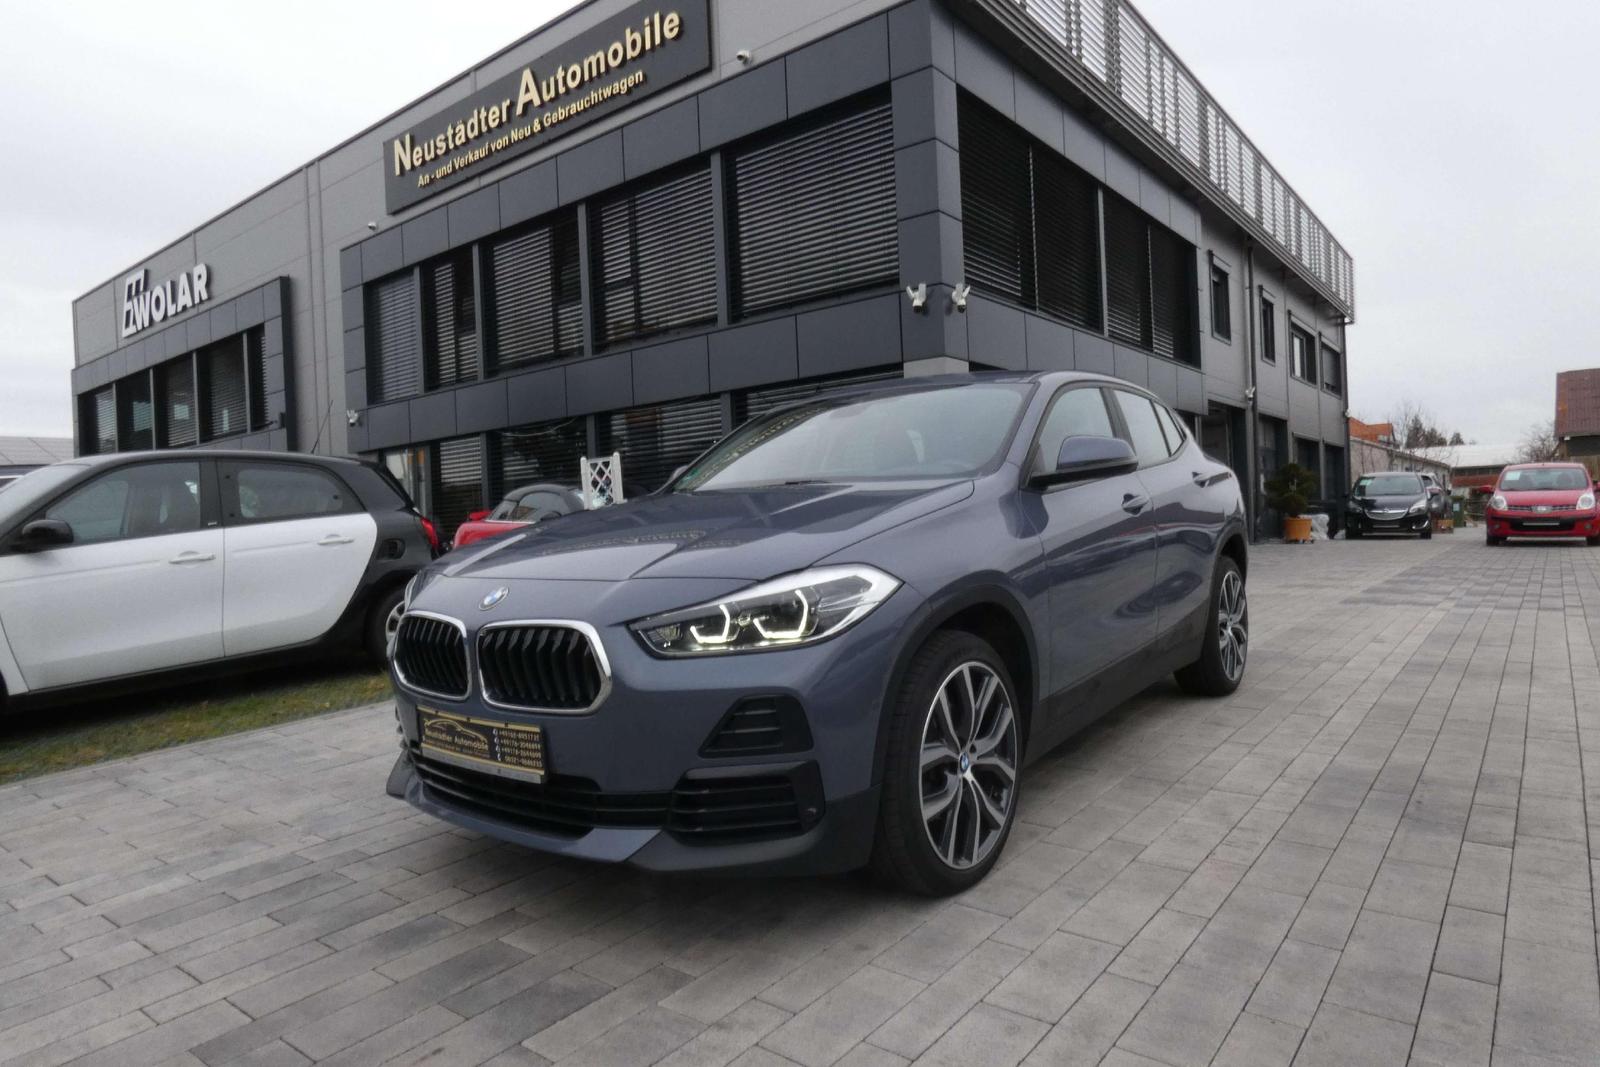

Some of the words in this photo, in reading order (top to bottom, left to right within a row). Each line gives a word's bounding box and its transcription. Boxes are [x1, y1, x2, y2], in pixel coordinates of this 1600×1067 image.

[393, 99, 511, 176] Neustädter
[516, 11, 680, 116] Automobile
[454, 142, 490, 171] Verkauf
[491, 135, 509, 153] von
[511, 125, 531, 144] Neu
[533, 117, 541, 132] &
[543, 69, 644, 127] Gebrauchtwagen
